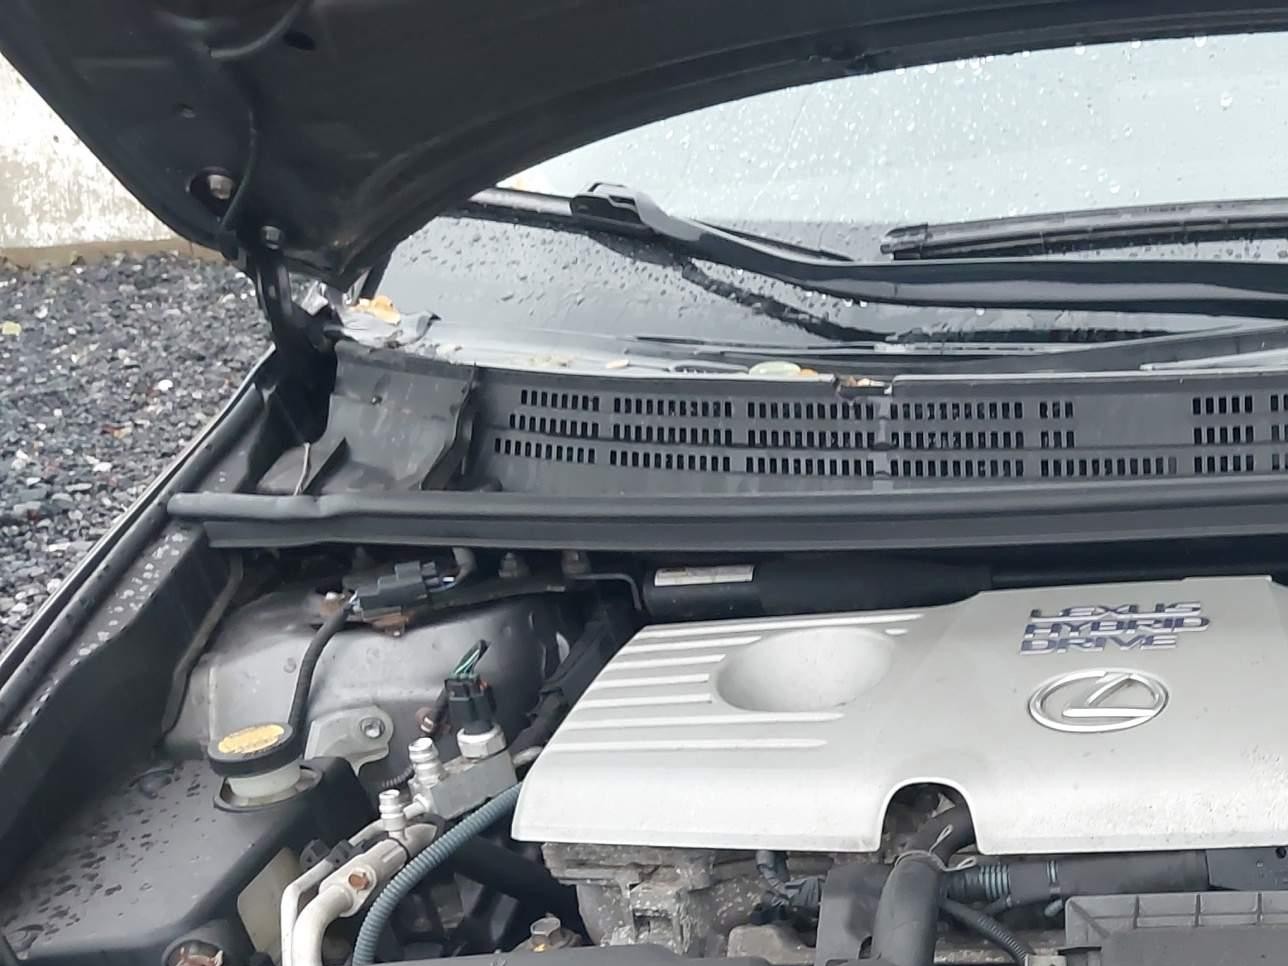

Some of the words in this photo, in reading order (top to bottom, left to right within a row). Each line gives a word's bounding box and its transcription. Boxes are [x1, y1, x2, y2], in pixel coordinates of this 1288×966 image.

[1029, 601, 1201, 622] LEXUS
[1024, 617, 1210, 639] HYBRID
[1019, 634, 1178, 656] DRIVE
